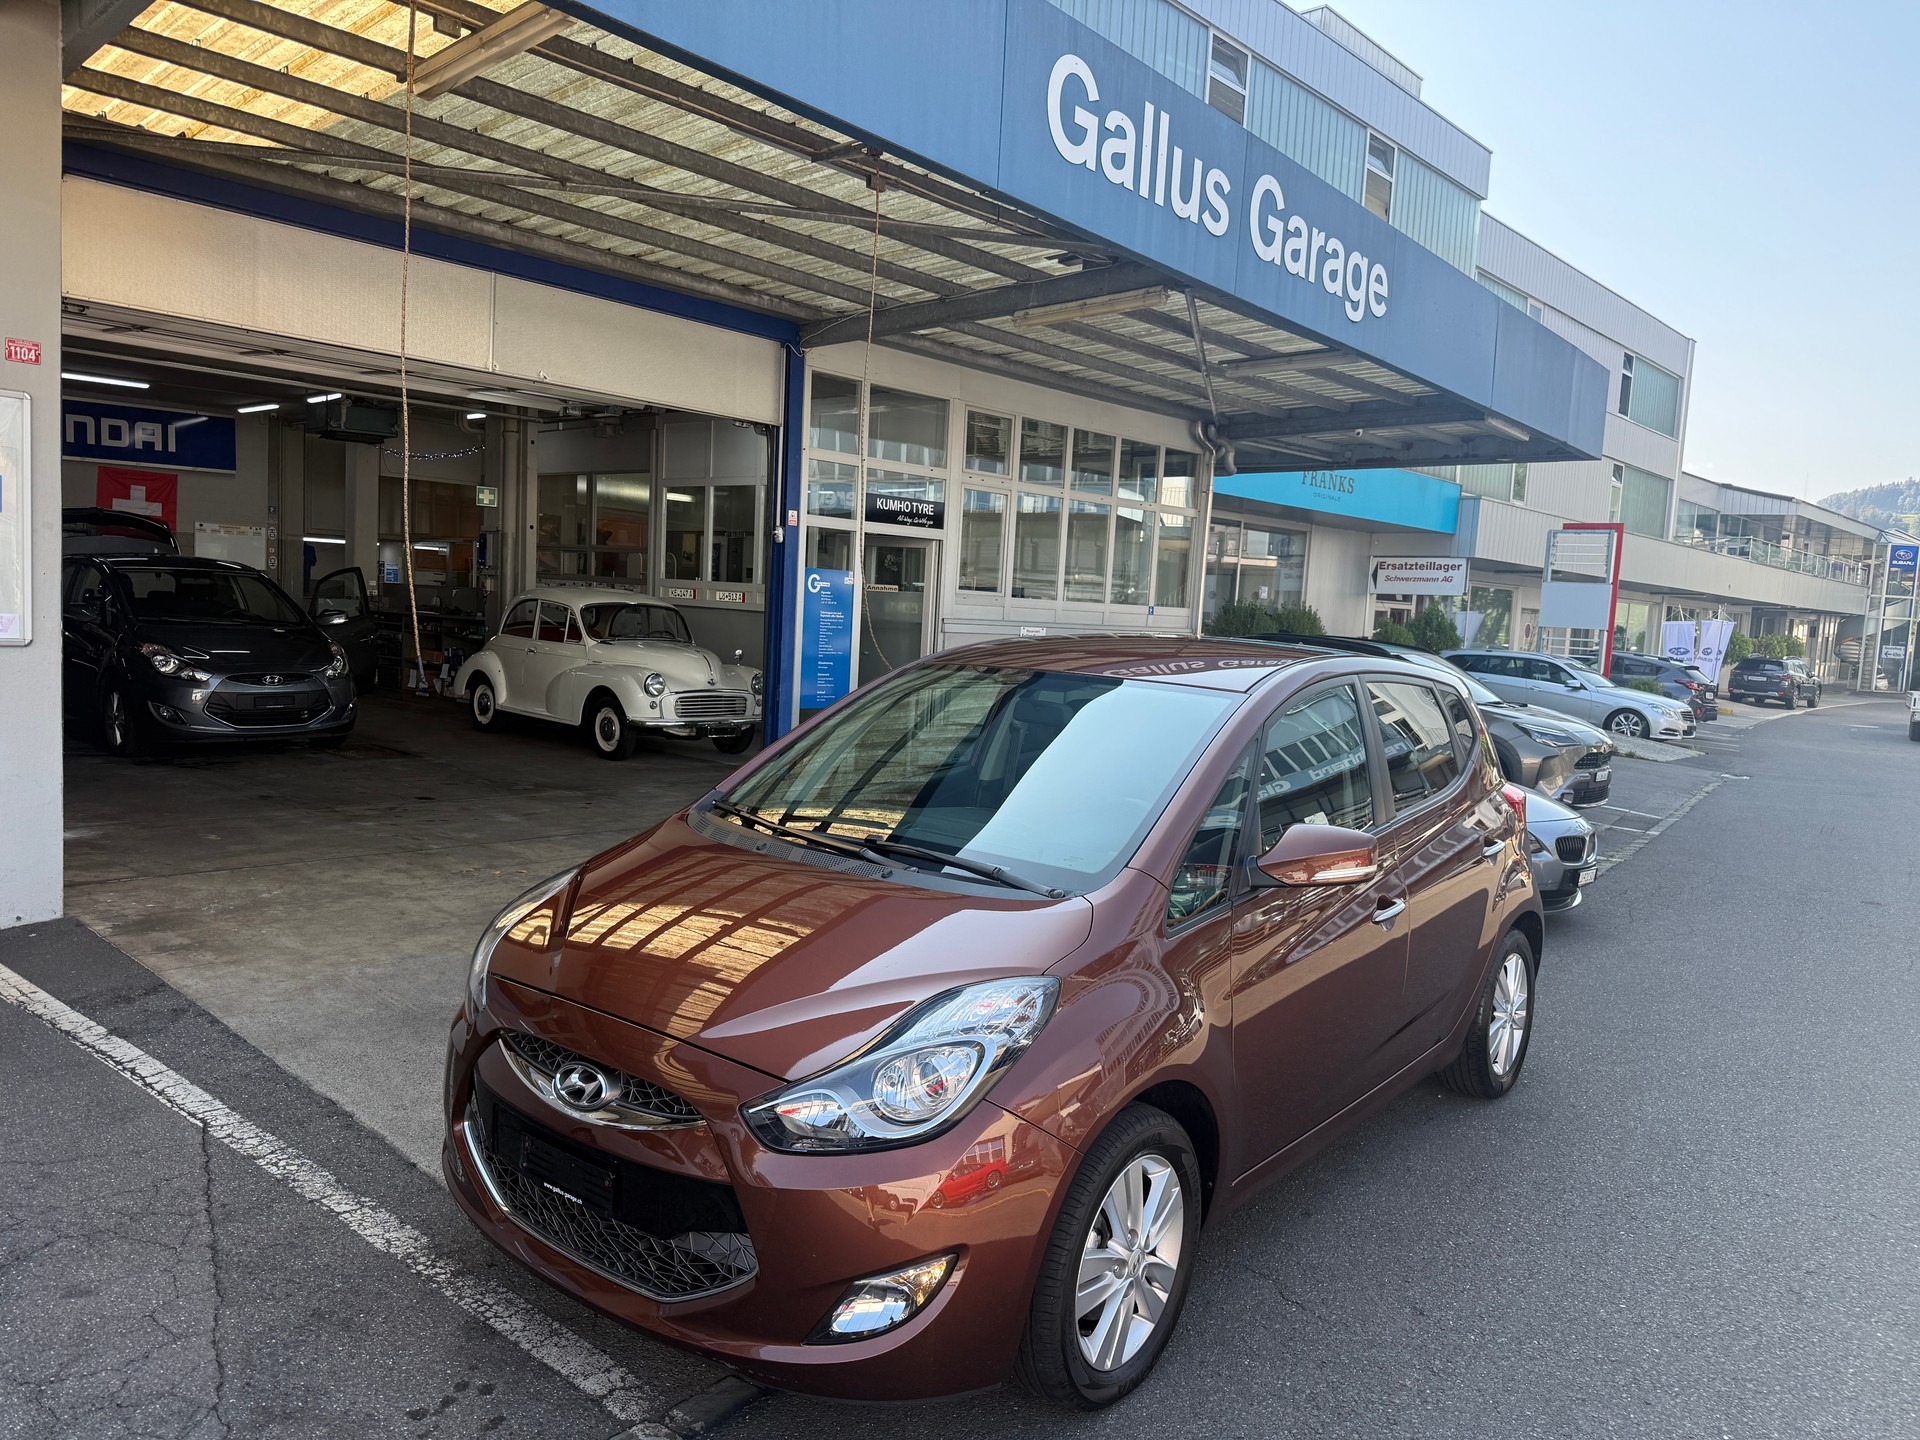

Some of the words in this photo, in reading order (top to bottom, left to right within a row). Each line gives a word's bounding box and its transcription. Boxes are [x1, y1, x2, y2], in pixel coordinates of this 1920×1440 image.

[1047, 53, 1231, 237] Gallus
[1250, 174, 1389, 323] Garage
[10, 346, 36, 362] 1104
[1301, 470, 1355, 495] FRANKS
[876, 498, 911, 513] KUMHO
[912, 502, 935, 515] TYRE
[1378, 561, 1463, 573] Ersatzteillager
[1384, 575, 1439, 583] Schwerzmann
[867, 584, 898, 592] Annahme
